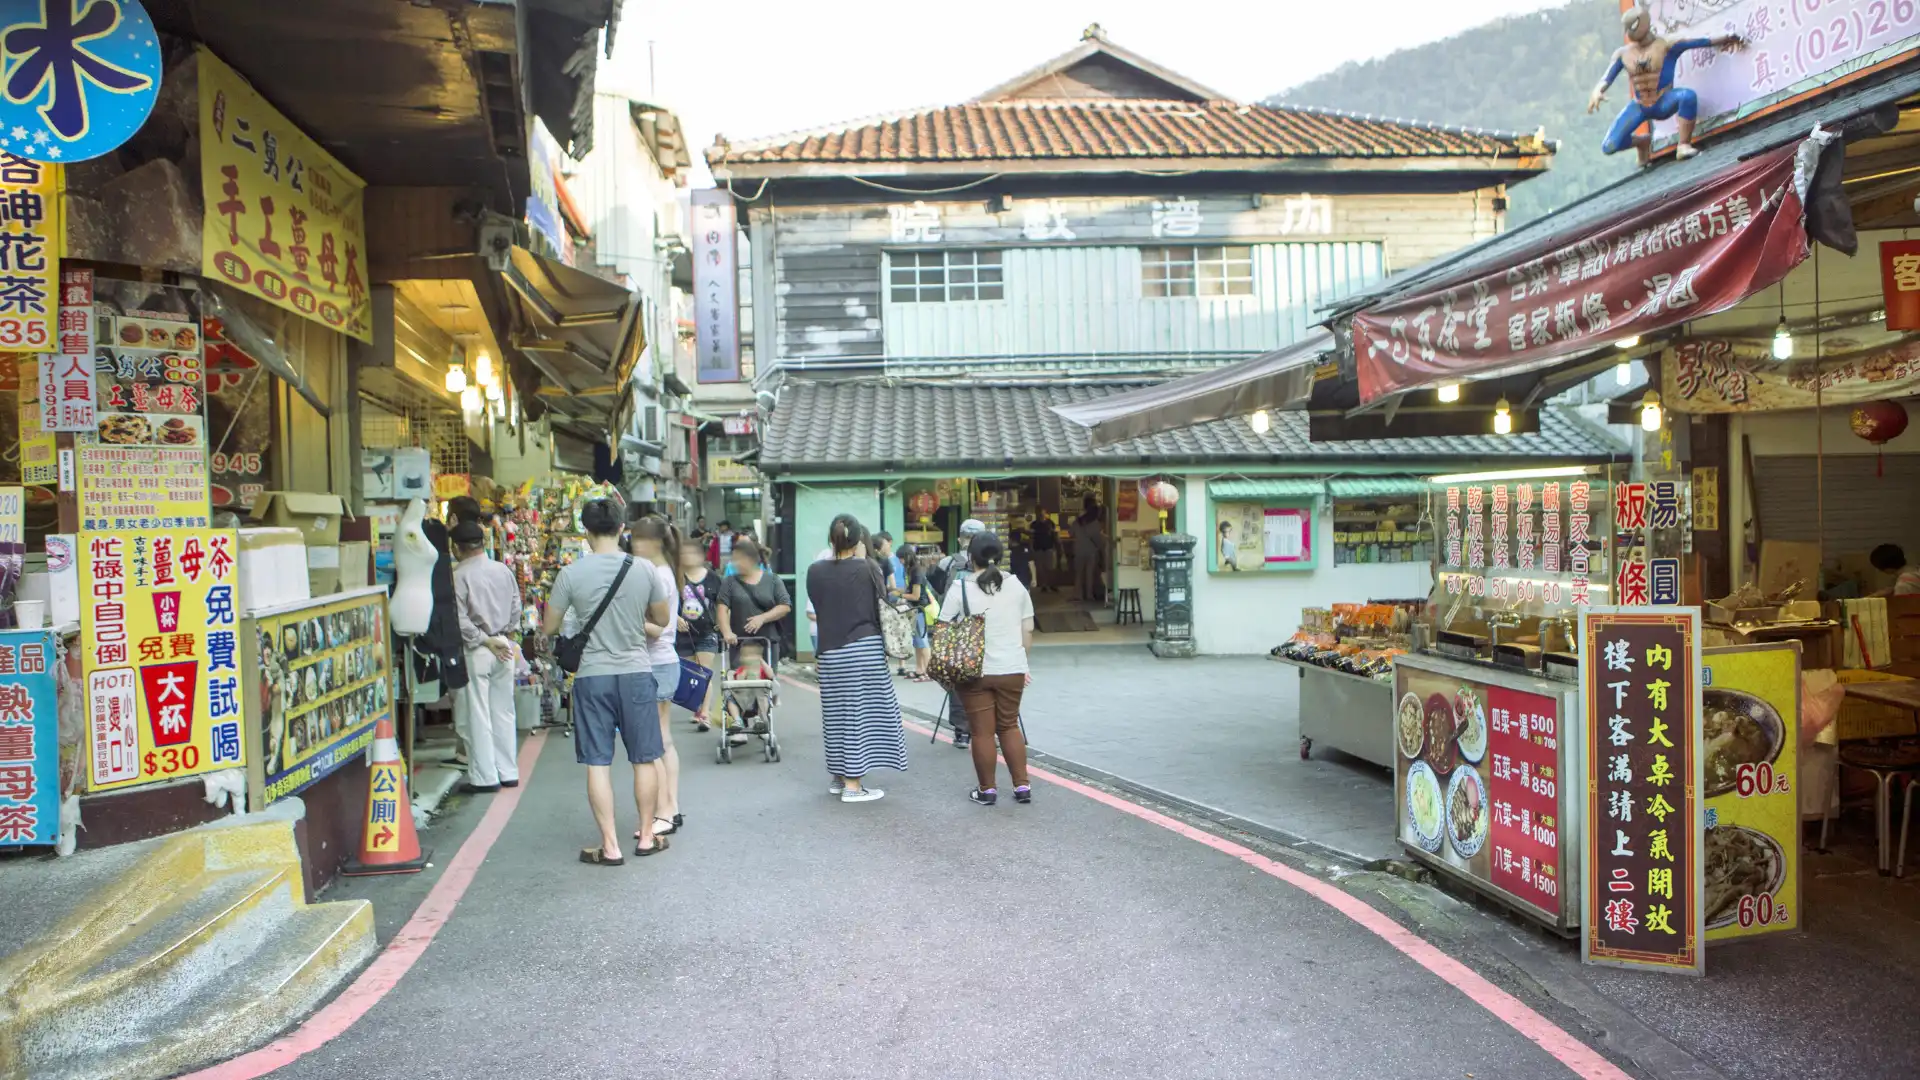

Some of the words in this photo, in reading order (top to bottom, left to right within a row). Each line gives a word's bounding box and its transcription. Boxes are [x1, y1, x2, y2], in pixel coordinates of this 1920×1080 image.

[0, 319, 47, 346] 35
[60, 310, 92, 402] 銷售人員
[210, 452, 262, 474] 945
[1570, 480, 1590, 606] 客家合菜
[1616, 481, 1647, 606] 粄條
[1648, 481, 1679, 605] 湯圓
[132, 536, 149, 587] 古早味手工
[153, 536, 234, 587] 薑母茶
[91, 538, 128, 665] 忙碌中自己倒
[1446, 575, 1463, 595] 50
[1469, 576, 1485, 597] 50
[1492, 577, 1509, 599] 50
[1516, 580, 1534, 601] 60
[1543, 582, 1561, 604] 60
[160, 595, 177, 629] 小杯
[138, 633, 197, 662] 免費
[93, 674, 133, 691] HOT!
[205, 586, 241, 764] 免費試喝
[156, 671, 188, 737] 大杯
[1491, 706, 1529, 741] 四菜一湯
[1530, 712, 1555, 736] 500
[143, 745, 201, 777] $30
[1492, 752, 1530, 788] 五菜一湯
[370, 767, 397, 824] 公廁
[1531, 775, 1556, 799] 850
[1603, 638, 1640, 934] 樓下客滿請上二樓
[1645, 642, 1677, 936] 內有大桌冷氣開放
[1736, 761, 1790, 798] 60元
[1494, 798, 1531, 836] 六菜一湯
[1532, 823, 1557, 848] 1000
[1494, 844, 1531, 883] 八菜一湯
[1532, 872, 1557, 897] 1500
[1737, 892, 1790, 929] 60元
